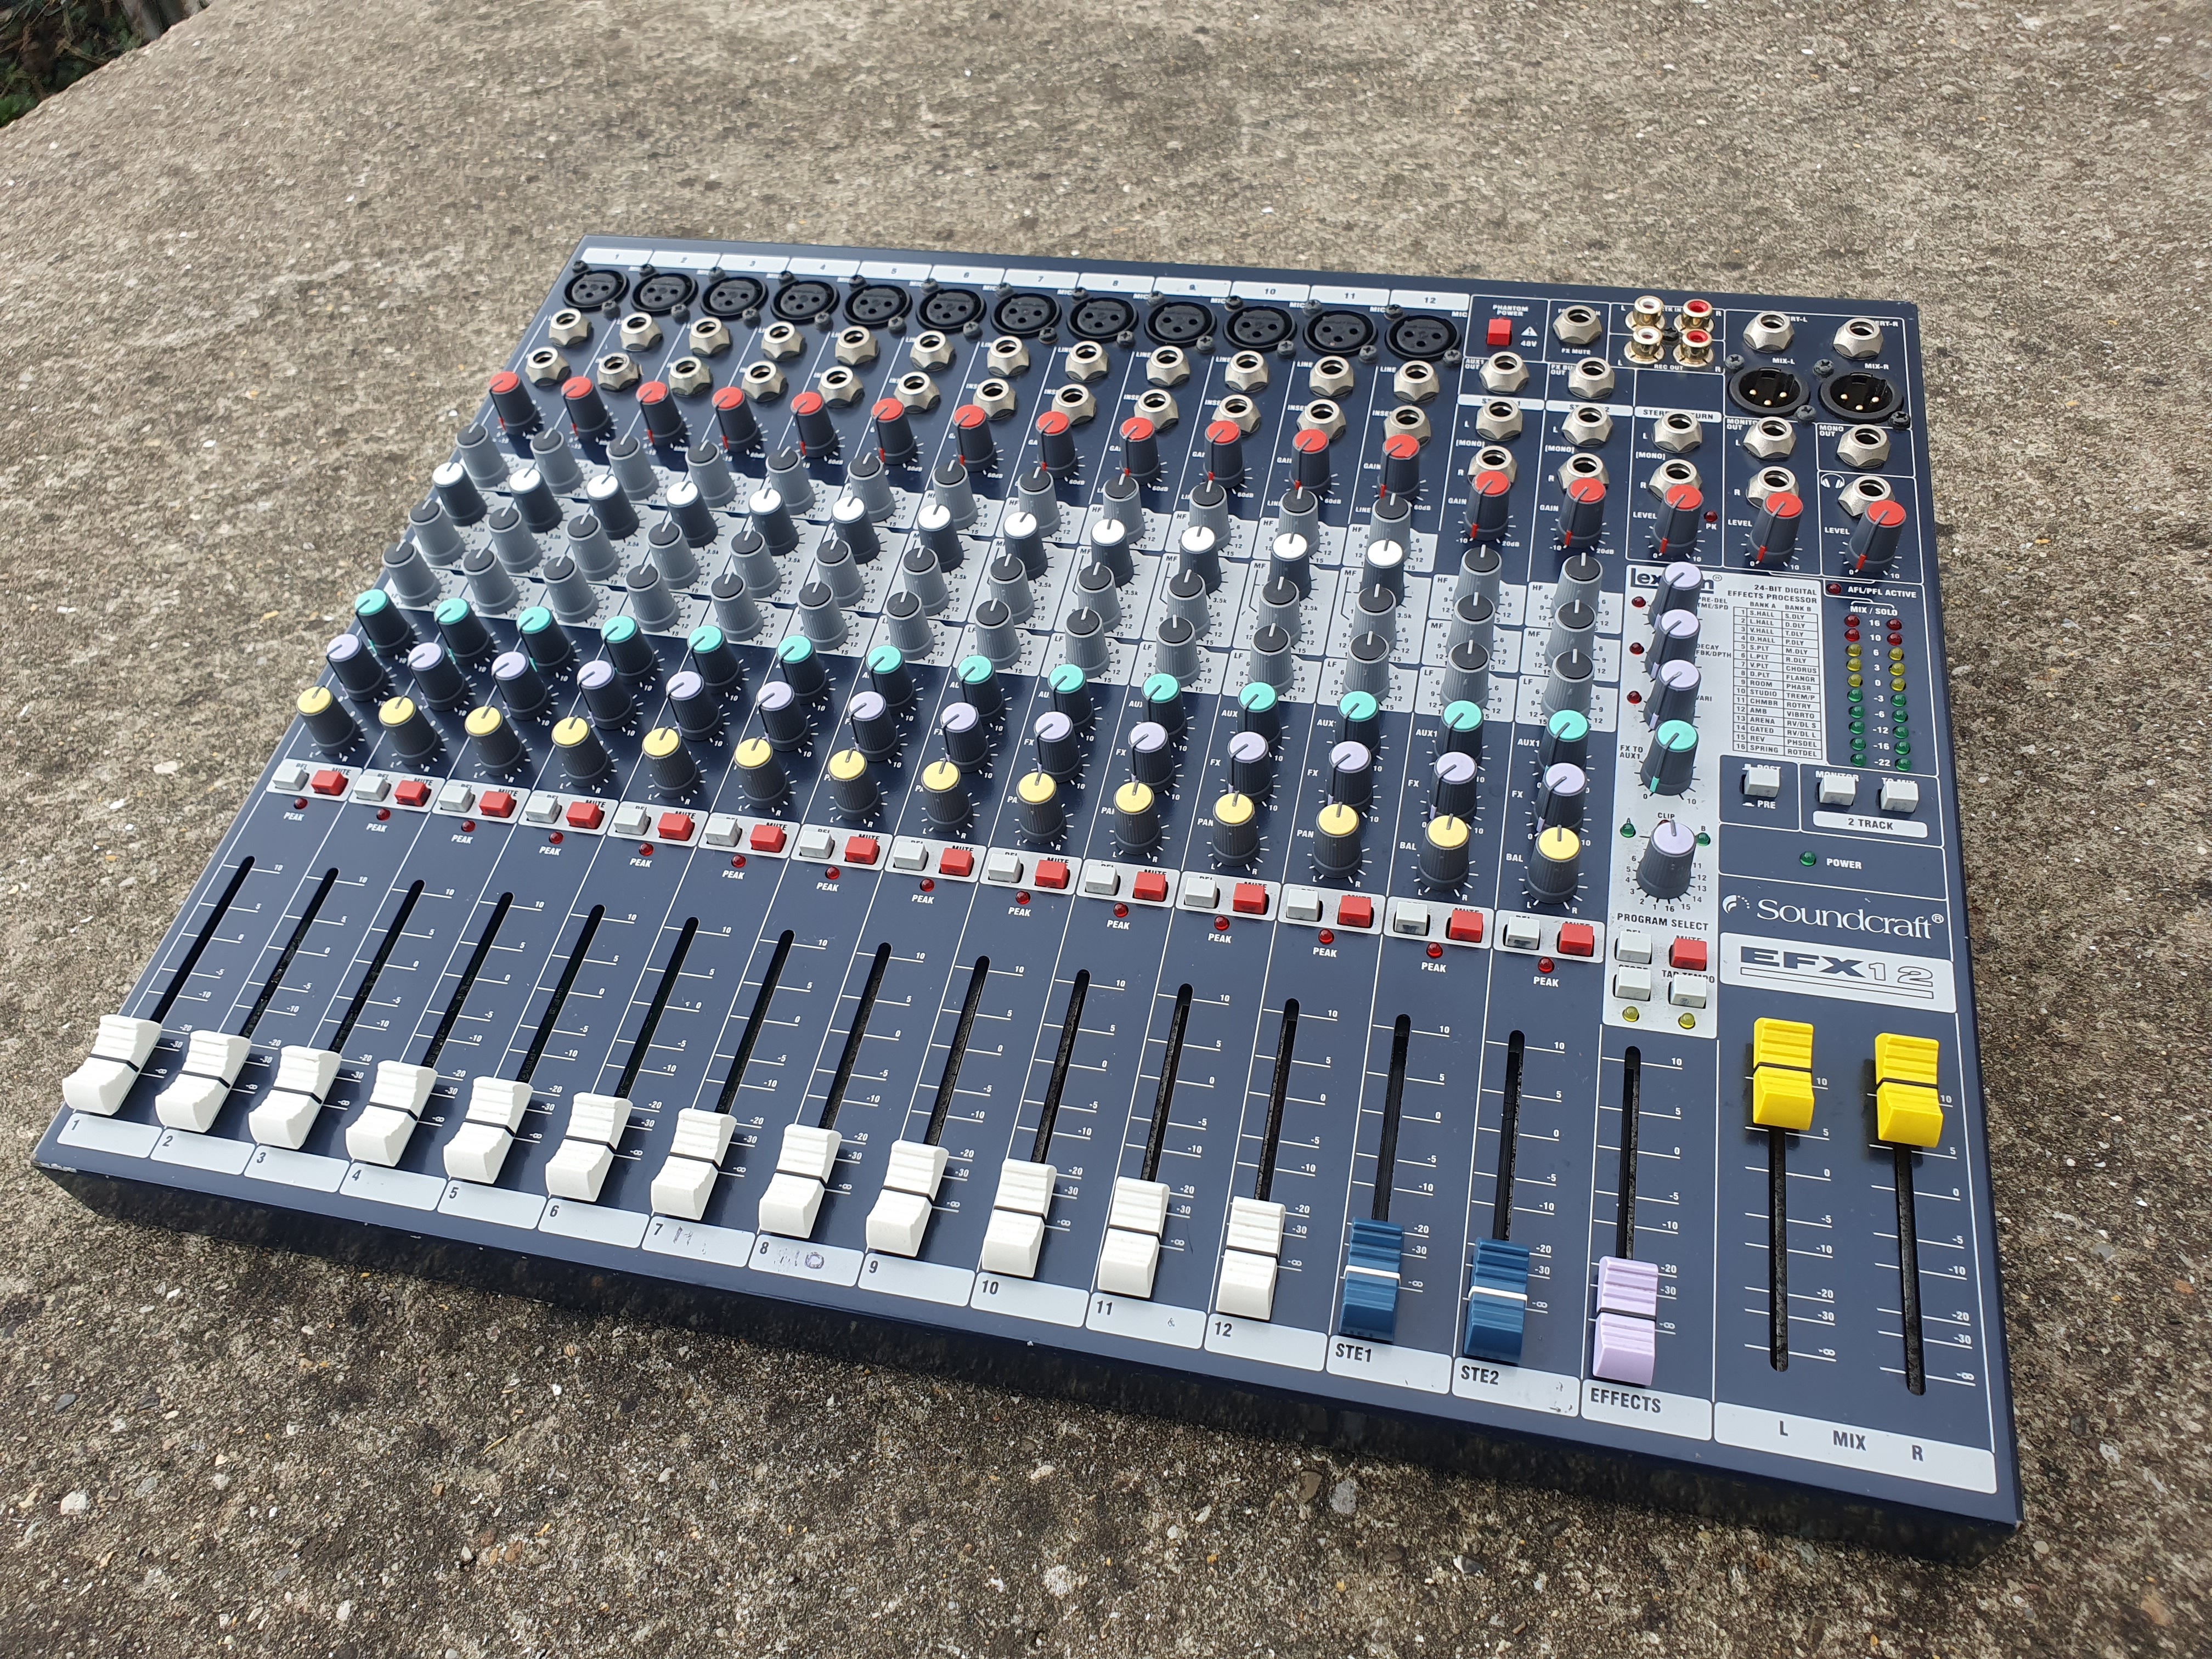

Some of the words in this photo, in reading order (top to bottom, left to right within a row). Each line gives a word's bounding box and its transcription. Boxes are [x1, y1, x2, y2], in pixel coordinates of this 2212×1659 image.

[1545, 445, 1575, 454] [MONO]
[1635, 452, 1666, 460] [MONO]
[1785, 587, 1816, 595] DIGITAL
[1848, 586, 1883, 595] AFL/PFL
[1885, 590, 1916, 598] ACTIVE
[1728, 590, 1763, 599] EFFECTS
[1767, 594, 1817, 603] PROCESSOR
[1875, 608, 1898, 616] SOLO
[1517, 738, 1539, 747] AUX1
[1787, 739, 1817, 747] PHSDEL
[1620, 744, 1630, 753] FX
[1787, 749, 1817, 757] ROTDEL
[1758, 800, 1776, 809] PRE
[284, 812, 304, 821] PEAK
[366, 823, 387, 832] PEAK
[1858, 819, 1893, 830] TRACK
[451, 834, 473, 844] PEAK
[539, 847, 561, 855] PEAK
[630, 858, 652, 867] PEAK
[1506, 853, 1523, 862] BAL
[1827, 858, 1861, 869] POWER
[722, 870, 745, 879] PEAK
[816, 882, 839, 891] PEAK
[912, 894, 934, 904] PEAK
[1008, 907, 1031, 917] PEAK
[1617, 913, 1667, 926] PROGRAM
[1671, 919, 1708, 930] SELECT
[1757, 898, 1932, 939] Soundcraft
[1107, 920, 1130, 929] PEAK
[1208, 933, 1232, 943] PEAK
[1313, 947, 1337, 957] PEAK
[1421, 962, 1446, 973] PEAK
[1740, 946, 1933, 989] EFX12
[1533, 977, 1559, 987] PEAK
[72, 1119, 80, 1130] 1
[162, 1136, 173, 1147] 2
[257, 1152, 266, 1163] 3
[352, 1170, 362, 1181] 4
[449, 1187, 459, 1199] 5
[550, 1205, 559, 1217] 6
[1821, 1215, 1831, 1223] -5
[654, 1223, 663, 1235] 7
[760, 1242, 769, 1254] 8
[1816, 1245, 1832, 1254] -10
[869, 1261, 878, 1273] 9
[983, 1280, 998, 1295] 10
[1816, 1289, 1833, 1299] -20
[1097, 1300, 1112, 1315] 11
[1818, 1311, 1834, 1321] -30
[1215, 1322, 1232, 1337] 12
[1336, 1343, 1372, 1362] STE1
[1461, 1365, 1499, 1385] STE2
[1591, 1387, 1661, 1413] EFFECTS
[1780, 1420, 1788, 1436] L
[1833, 1430, 1866, 1451] MIX
[1912, 1444, 1923, 1462] R
